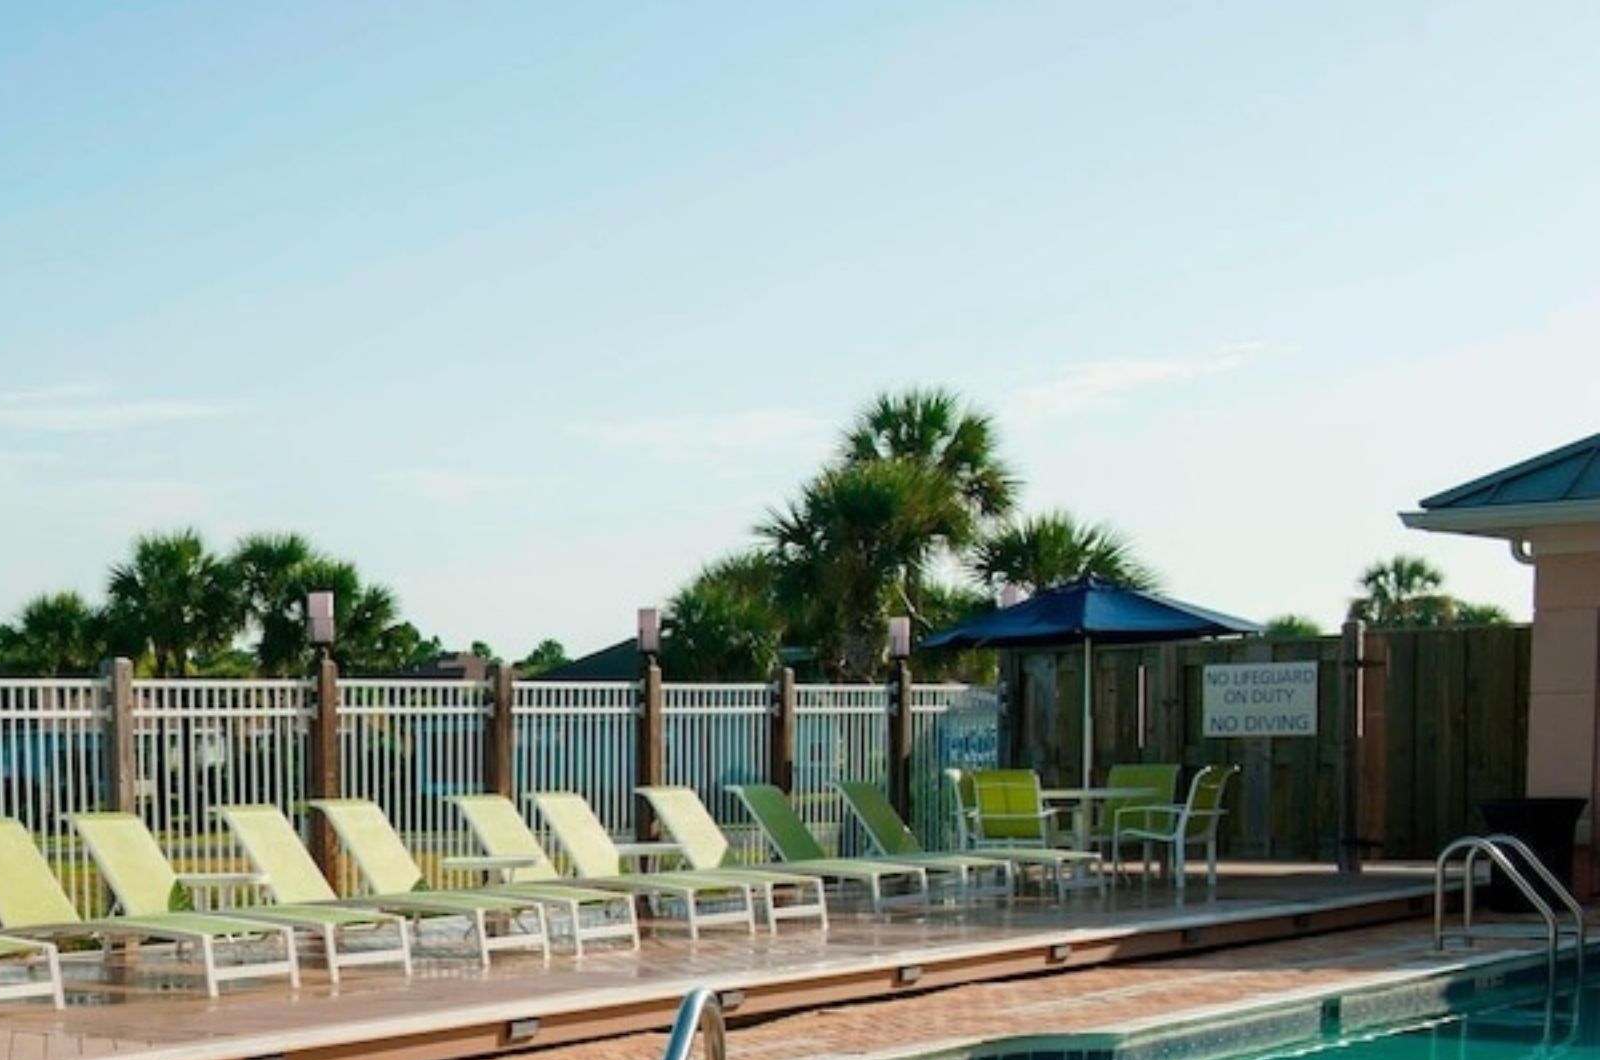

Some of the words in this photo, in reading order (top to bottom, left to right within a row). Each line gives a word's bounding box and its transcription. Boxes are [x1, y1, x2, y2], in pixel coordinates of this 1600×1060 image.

[1207, 671, 1229, 687] NO
[1234, 669, 1315, 686] LIFEGUARD
[1223, 689, 1248, 704] ON
[1252, 688, 1296, 703] DUTY
[1210, 715, 1238, 732] NO
[1244, 713, 1311, 732] DIVING
